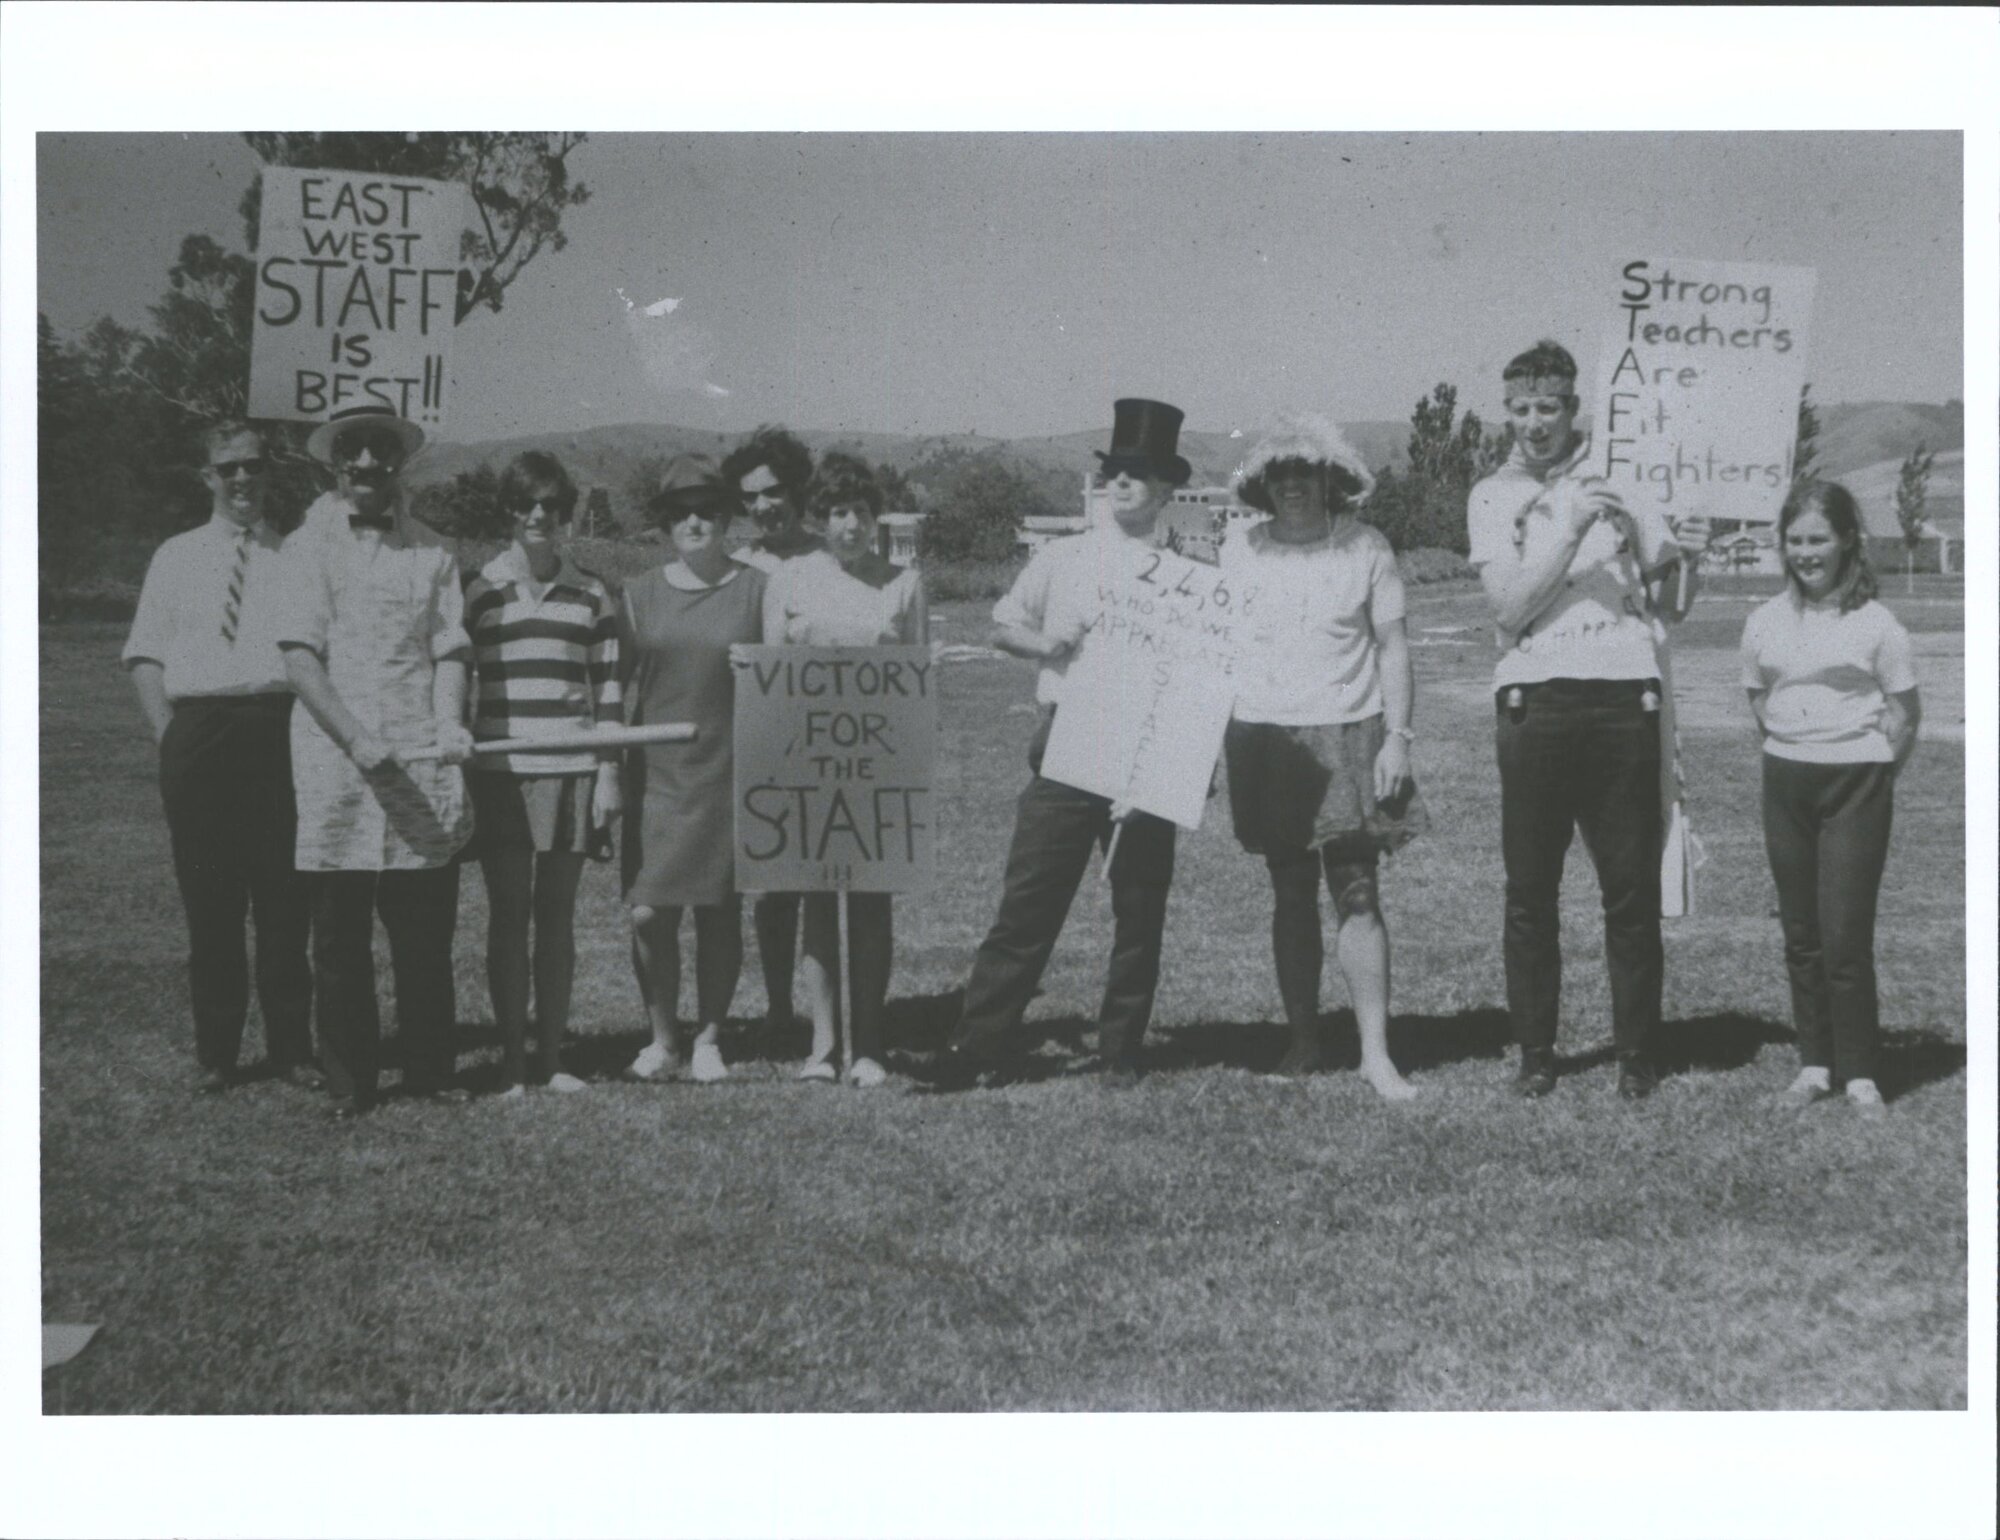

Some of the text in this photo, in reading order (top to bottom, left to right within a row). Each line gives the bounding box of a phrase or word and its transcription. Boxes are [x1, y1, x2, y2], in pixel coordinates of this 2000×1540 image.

[302, 178, 424, 228] EAST
[303, 226, 422, 265] WEST
[259, 257, 456, 336] STAFF
[1621, 260, 1772, 325] Strong
[1619, 303, 1793, 353] Teachers
[331, 332, 372, 367] IS
[1610, 347, 1698, 388] Are
[1608, 393, 1672, 434] Fit
[753, 660, 932, 697] VICTORY
[805, 711, 896, 755] FOR
[810, 756, 875, 780] THE
[743, 784, 930, 864] STAFF
